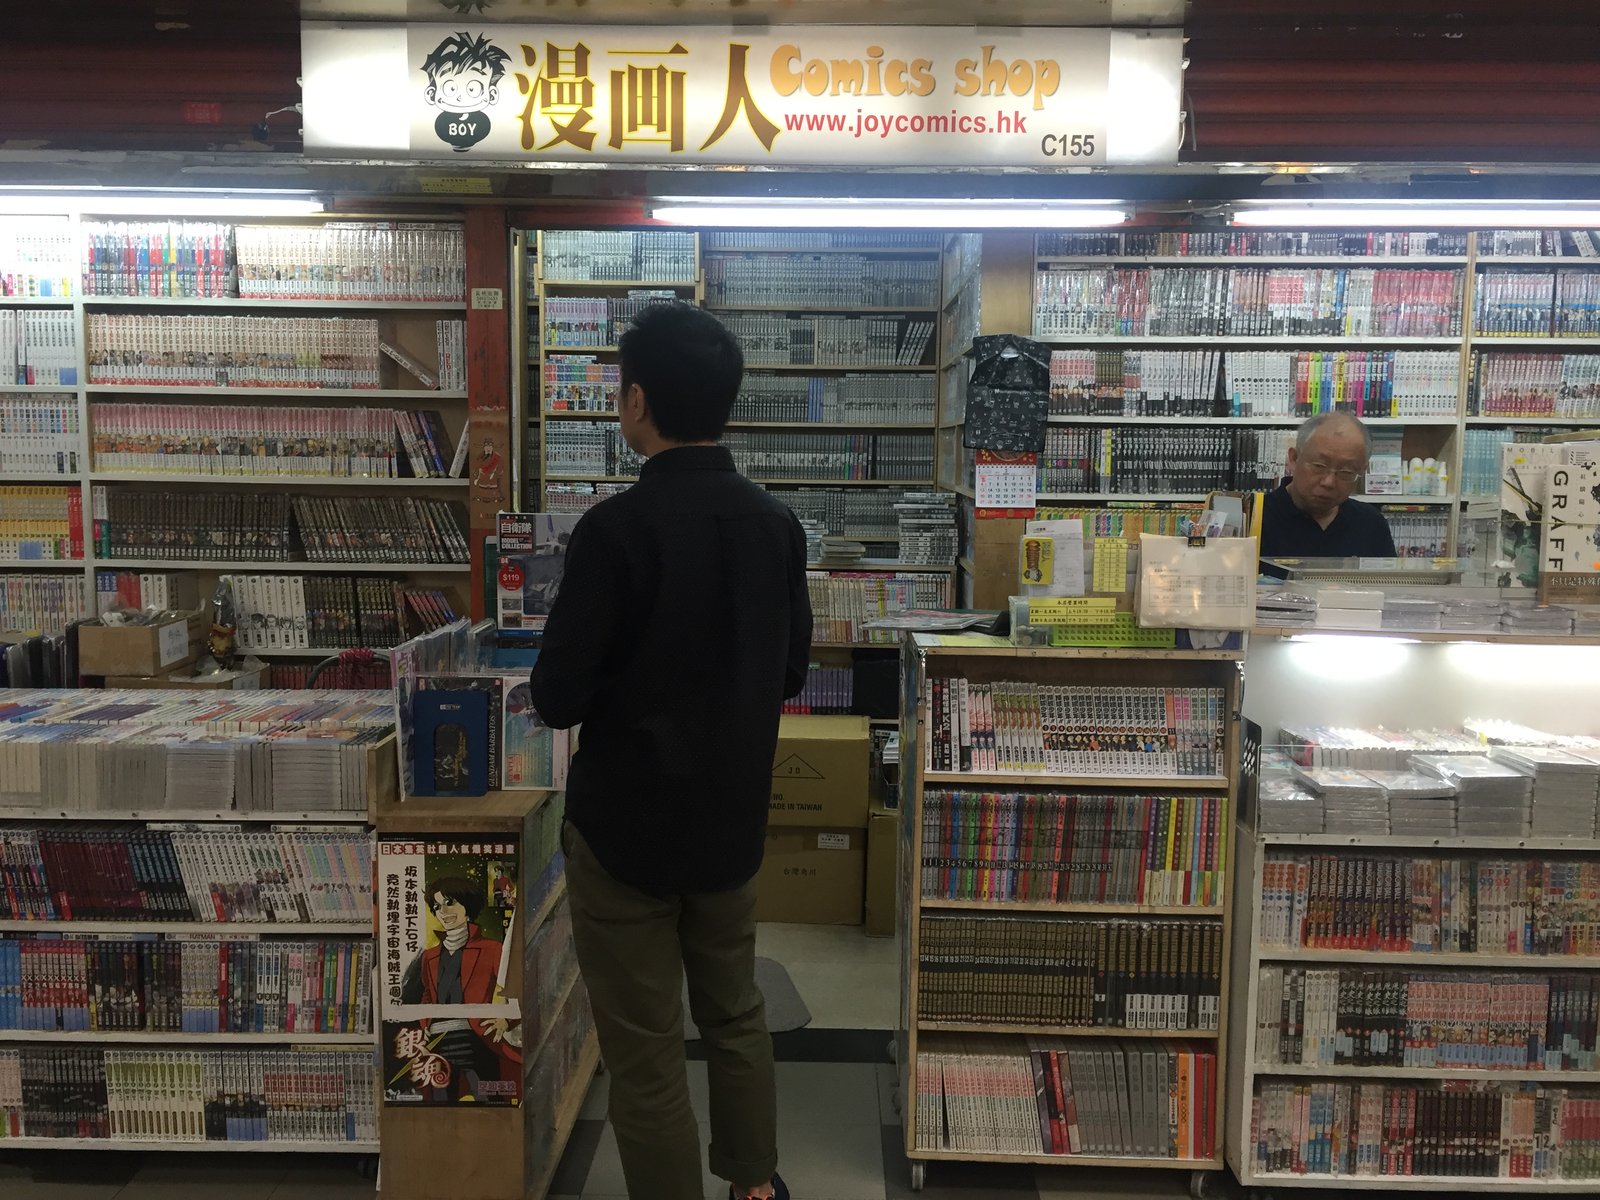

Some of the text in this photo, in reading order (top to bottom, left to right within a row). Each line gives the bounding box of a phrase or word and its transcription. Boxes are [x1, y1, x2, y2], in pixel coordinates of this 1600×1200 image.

[514, 41, 781, 152] 漫画人
[769, 44, 1061, 111] Comics shop
[448, 122, 477, 136] BOY
[785, 109, 1027, 138] www.joycomics.hk
[1041, 134, 1095, 157] C155
[1549, 470, 1569, 571] GRAFF
[488, 715, 496, 787] GUNDAM BARBATOS
[797, 803, 823, 811] TAIWAN
